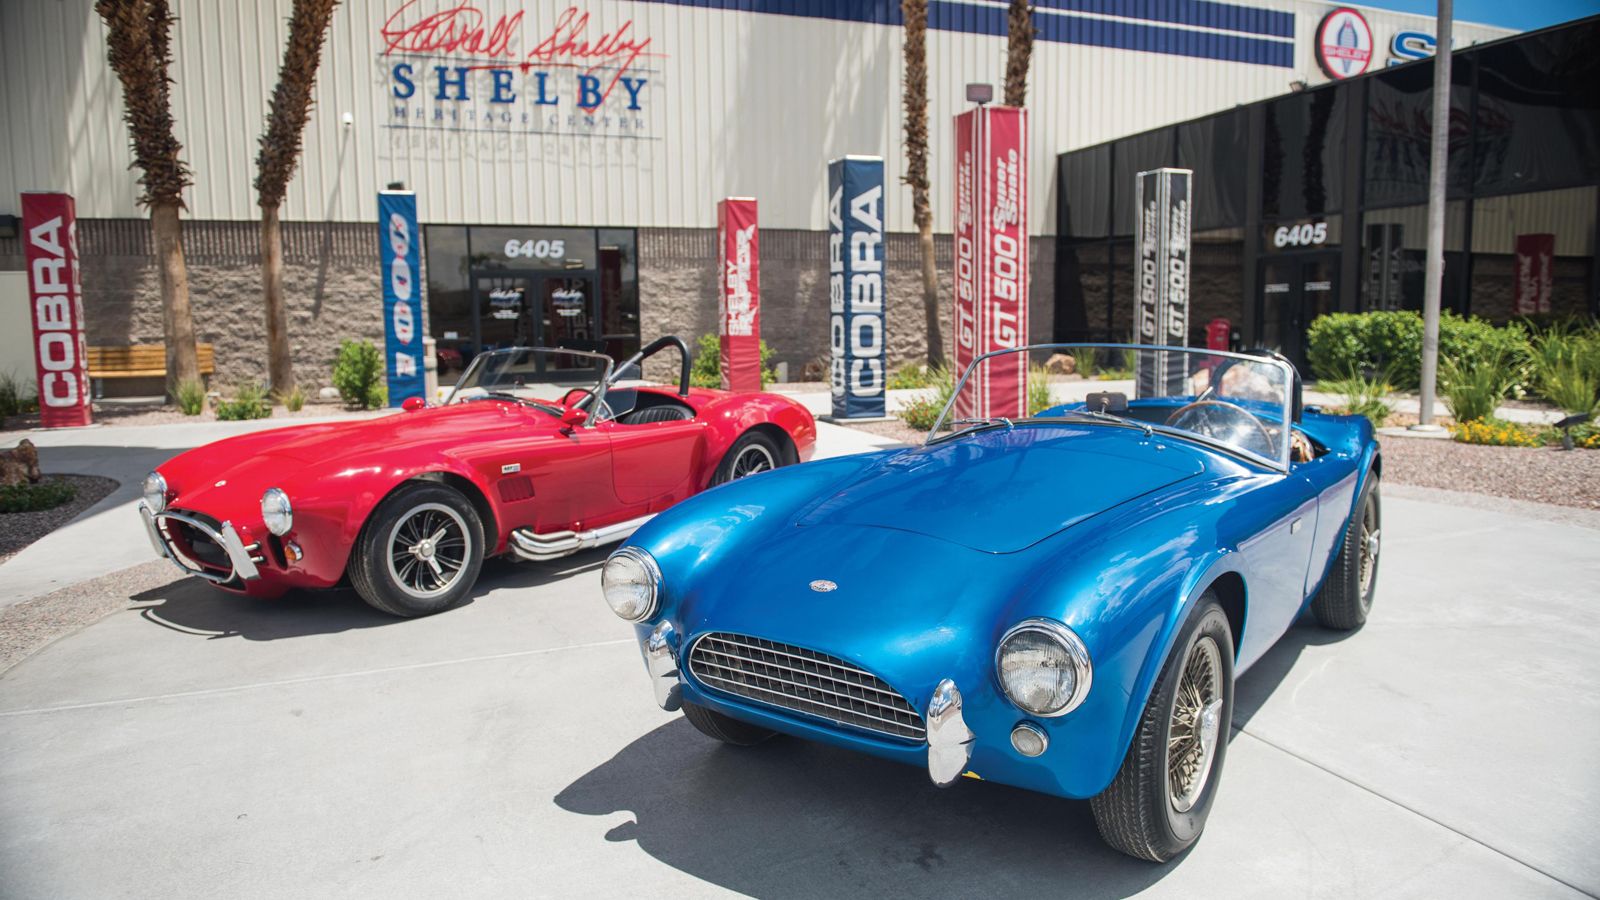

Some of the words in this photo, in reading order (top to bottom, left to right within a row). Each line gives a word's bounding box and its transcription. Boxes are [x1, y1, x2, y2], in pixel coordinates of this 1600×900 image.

[392, 63, 647, 111] SHELBY
[527, 6, 672, 114] Shelby
[395, 106, 530, 124] HERITAGE
[549, 113, 645, 129] CENTER
[993, 157, 1006, 233] Super
[1005, 148, 1018, 226] Snake
[504, 239, 565, 258] 6405
[1274, 222, 1328, 248] 6405
[727, 259, 739, 337] SHELBY
[828, 184, 845, 397] COBRA
[850, 184, 884, 397] COBRA
[958, 238, 973, 302] 500
[993, 233, 1018, 302] 500
[29, 215, 79, 408] COBRA
[958, 303, 974, 349] GT
[993, 302, 1018, 349] GT
[1141, 305, 1156, 338] GT
[1168, 305, 1185, 338] GT
